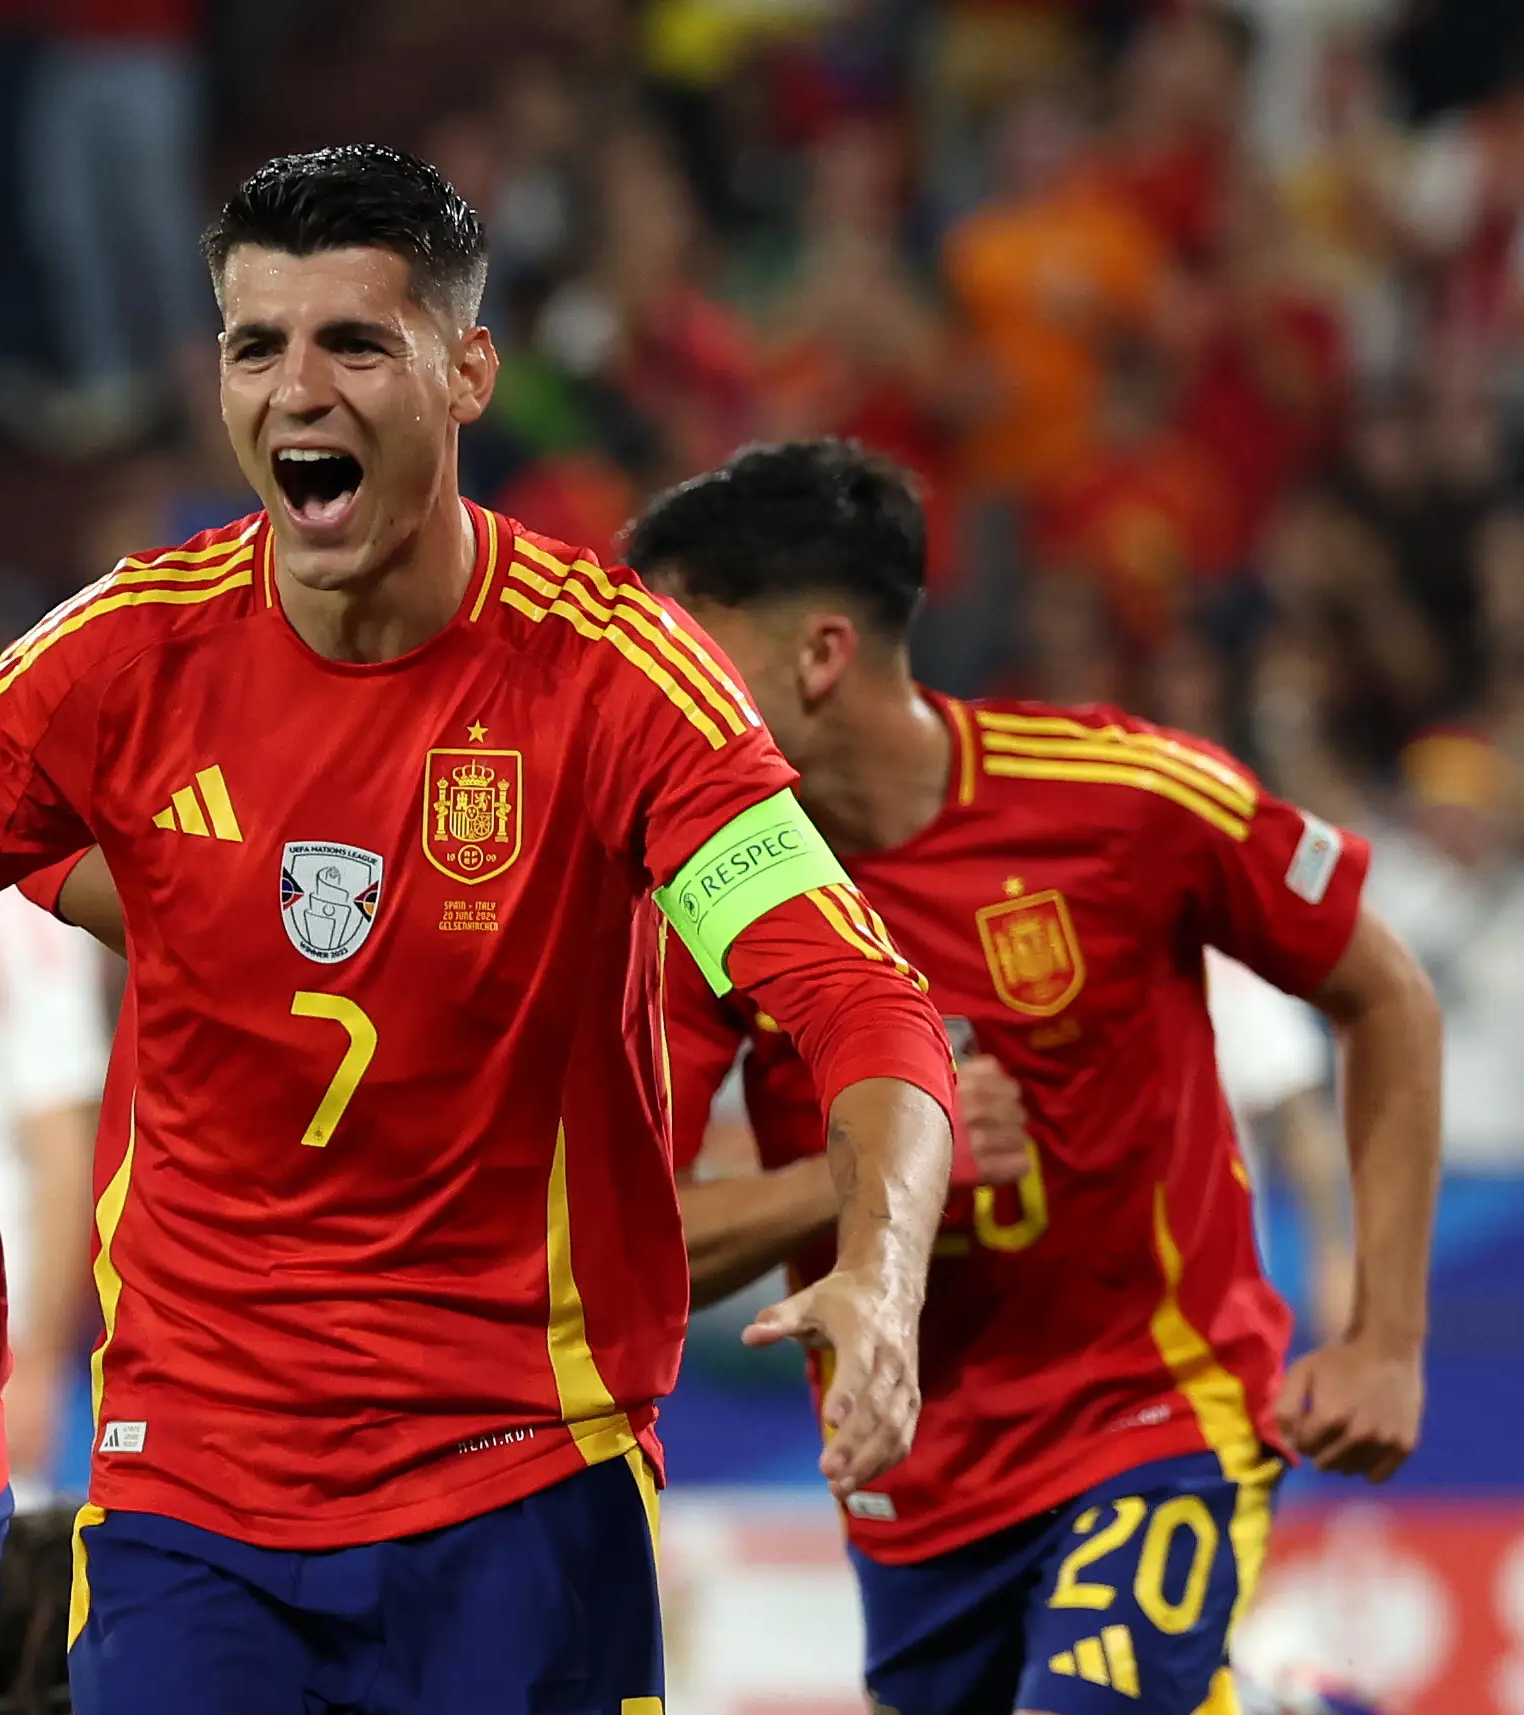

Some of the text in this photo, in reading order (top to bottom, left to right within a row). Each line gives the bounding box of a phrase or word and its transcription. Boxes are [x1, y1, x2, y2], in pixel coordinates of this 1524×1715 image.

[289, 846, 378, 865] UEFA NATIONS LEAGUE
[444, 901, 466, 910] SPAIN
[475, 901, 496, 910] ITALY
[443, 911, 453, 920] 20
[476, 911, 496, 920] 2024
[300, 941, 329, 959] WINNER
[290, 991, 377, 1148] 7
[1046, 1494, 1220, 1635] 20
